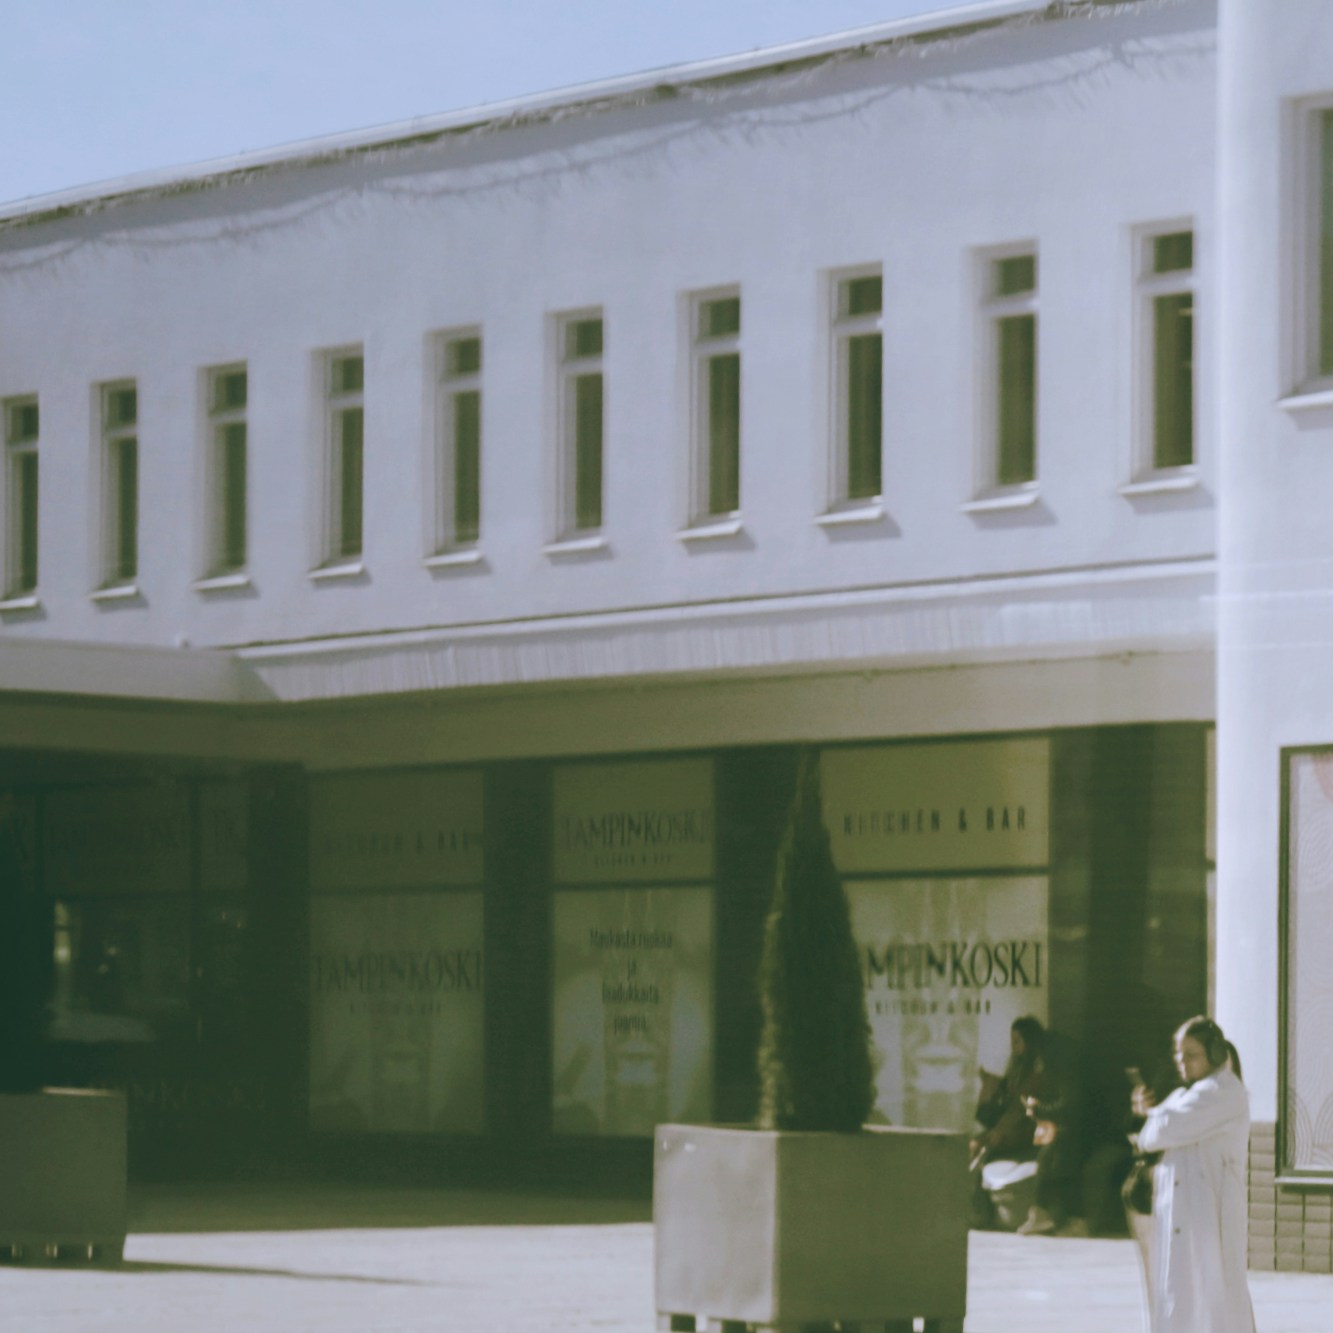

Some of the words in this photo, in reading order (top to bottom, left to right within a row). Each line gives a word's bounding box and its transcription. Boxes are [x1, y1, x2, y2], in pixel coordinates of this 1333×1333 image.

[843, 809, 941, 836] KITCHEN
[958, 807, 967, 833] &
[986, 805, 1027, 832] BAR
